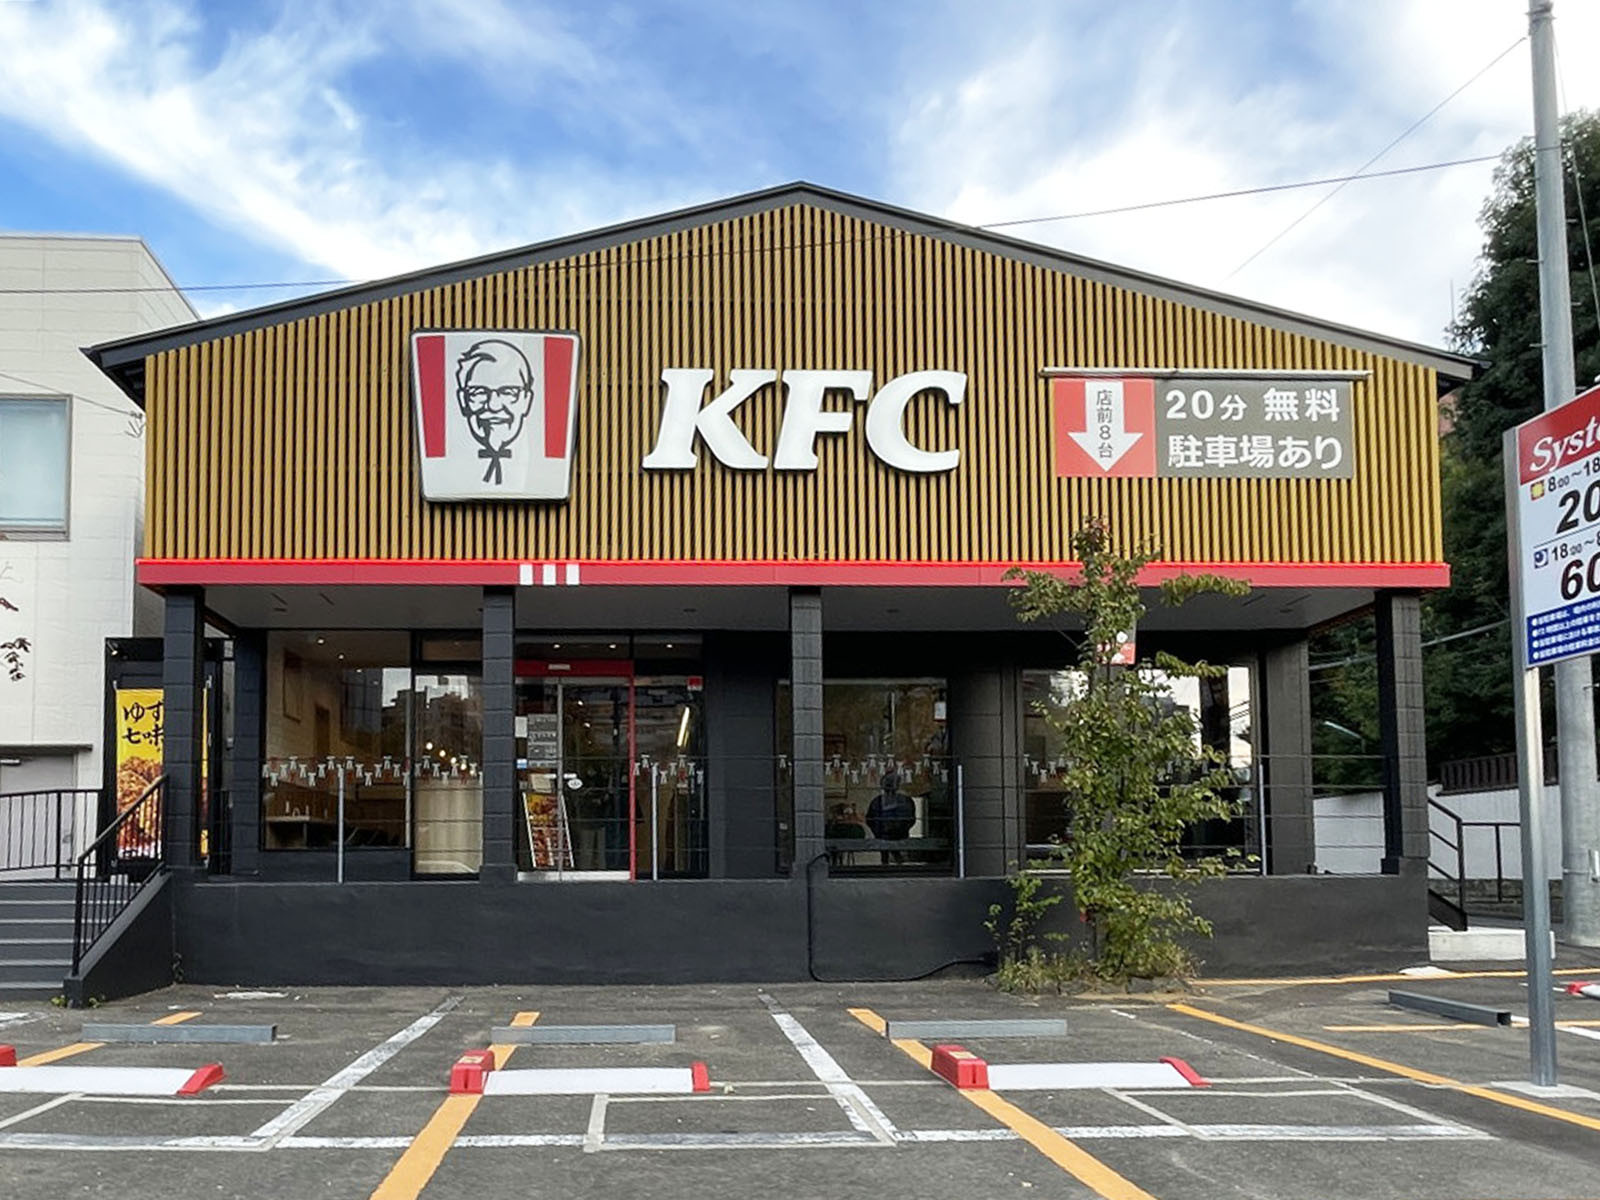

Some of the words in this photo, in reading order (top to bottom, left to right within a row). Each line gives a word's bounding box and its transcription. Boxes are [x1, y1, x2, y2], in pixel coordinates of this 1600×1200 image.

[642, 368, 967, 472] KFC
[1096, 389, 1113, 458] 店前8台
[1165, 389, 1247, 421] 20分
[1263, 387, 1340, 422] 無料
[1168, 434, 1342, 470] 駐車場あり
